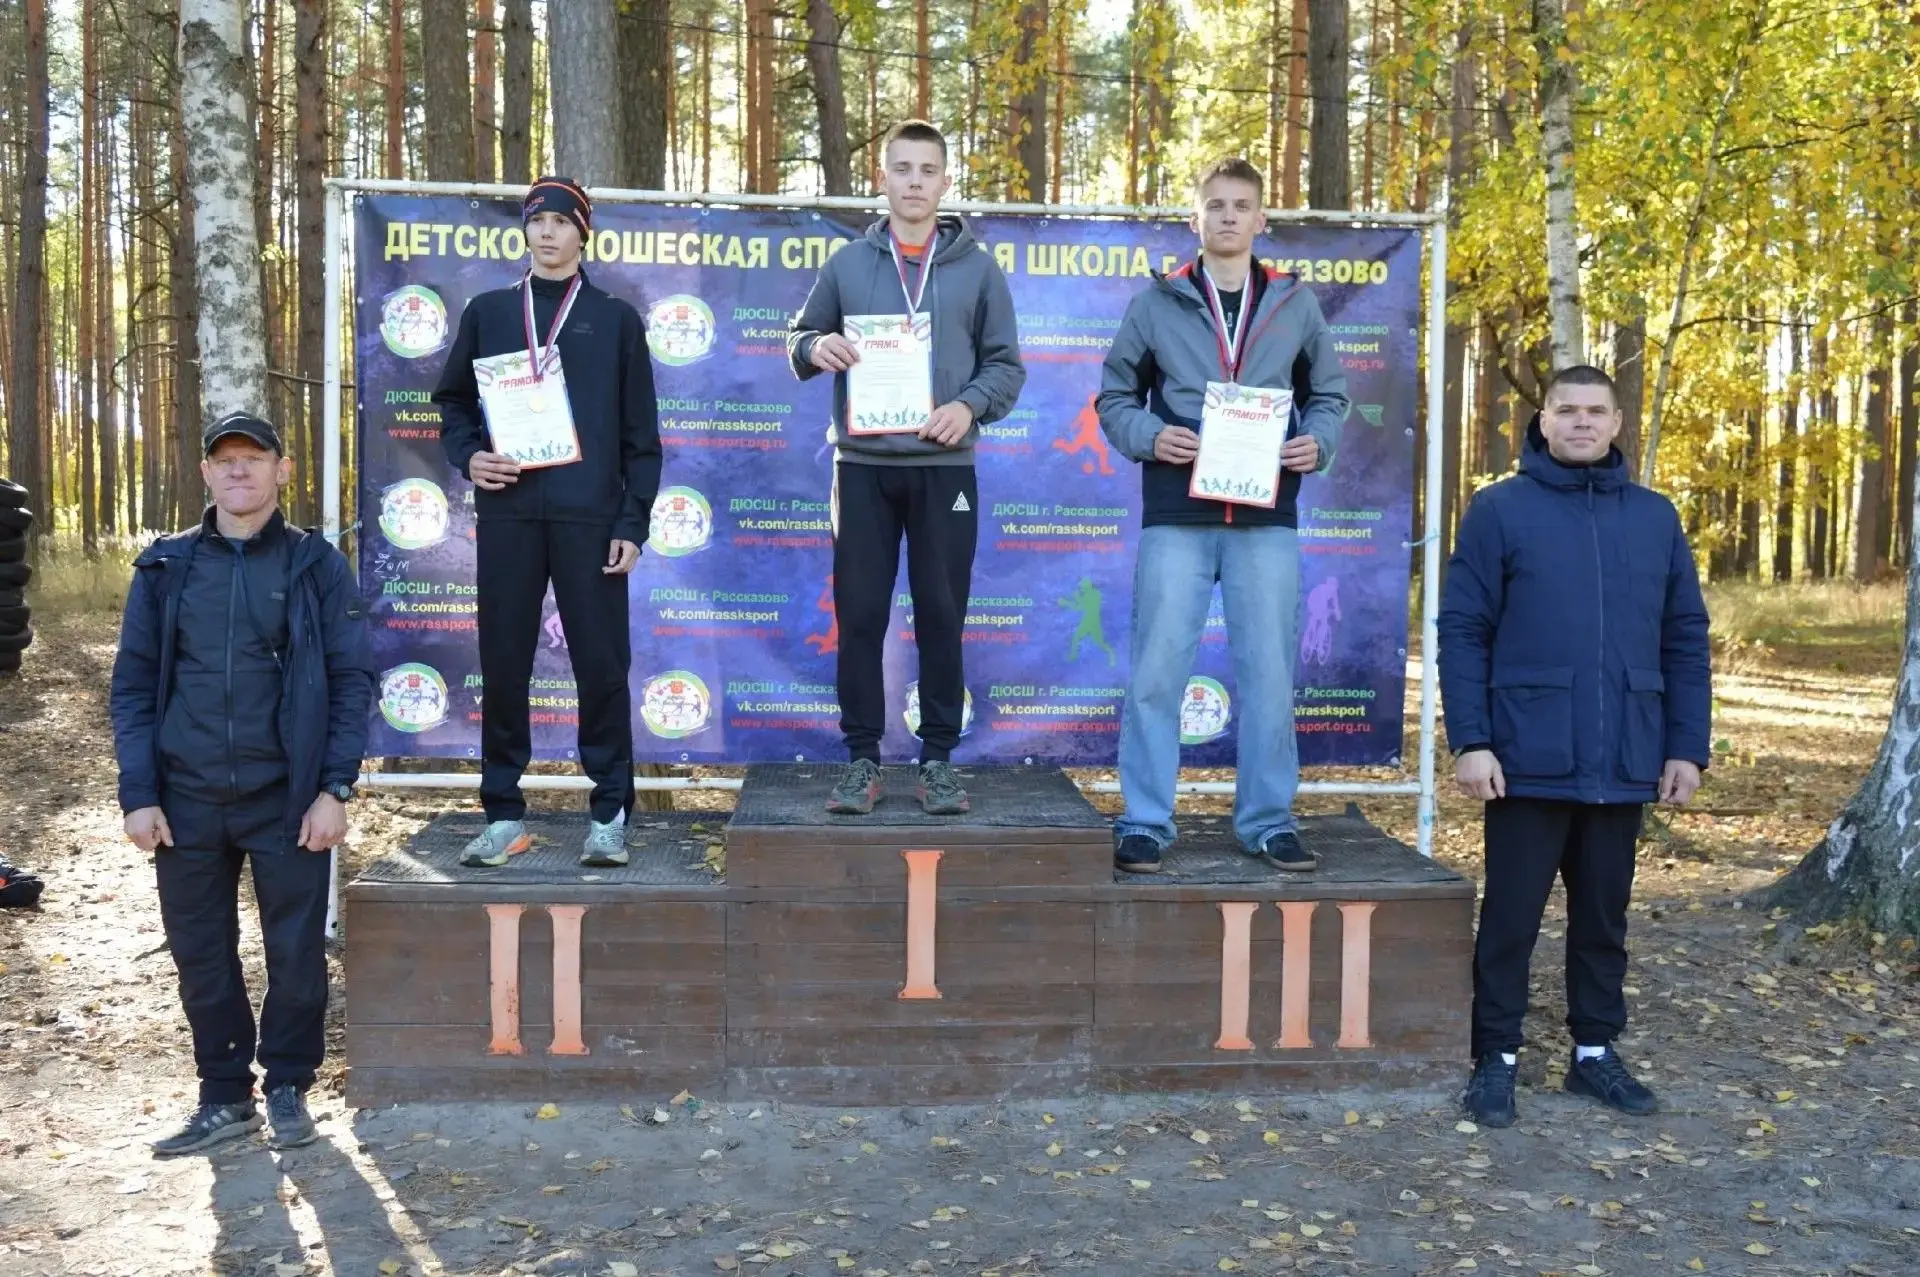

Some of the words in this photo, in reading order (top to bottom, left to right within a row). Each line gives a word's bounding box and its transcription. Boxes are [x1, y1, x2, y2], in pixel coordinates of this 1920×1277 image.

[1026, 243, 1151, 278] ШКОЛА
[733, 307, 780, 321] ДЮСШ
[741, 327, 789, 338] vk.com
[1329, 325, 1389, 335] ссказово
[384, 390, 432, 404] ДЮСШ
[715, 400, 792, 413] Рассказово
[395, 410, 442, 422] vk.com
[1221, 408, 1270, 422] ГРАМОТА
[662, 418, 783, 434] vk.com/rassksport
[729, 498, 776, 513] ДЮСШ
[792, 501, 831, 512] Расск
[992, 503, 1039, 517] ДЮСШ
[739, 518, 832, 530] vk.com/rassks
[1001, 522, 1118, 538] vk.com/rassksport
[383, 582, 430, 595] ДЮСШ
[446, 583, 478, 595] Расс
[650, 588, 697, 602] ДЮСШ
[392, 602, 478, 614] vk.com/rassk
[659, 608, 779, 624] vk.com/rassksport
[726, 682, 773, 695] ДЮСШ
[790, 683, 838, 694] Расска
[989, 685, 1035, 698] ДЮСШ
[1051, 686, 1125, 698] Рассказово
[1304, 687, 1376, 698] Рассказово
[737, 702, 841, 715] vk.com/rassksp
[999, 704, 1116, 719] vk.com/rassksport
